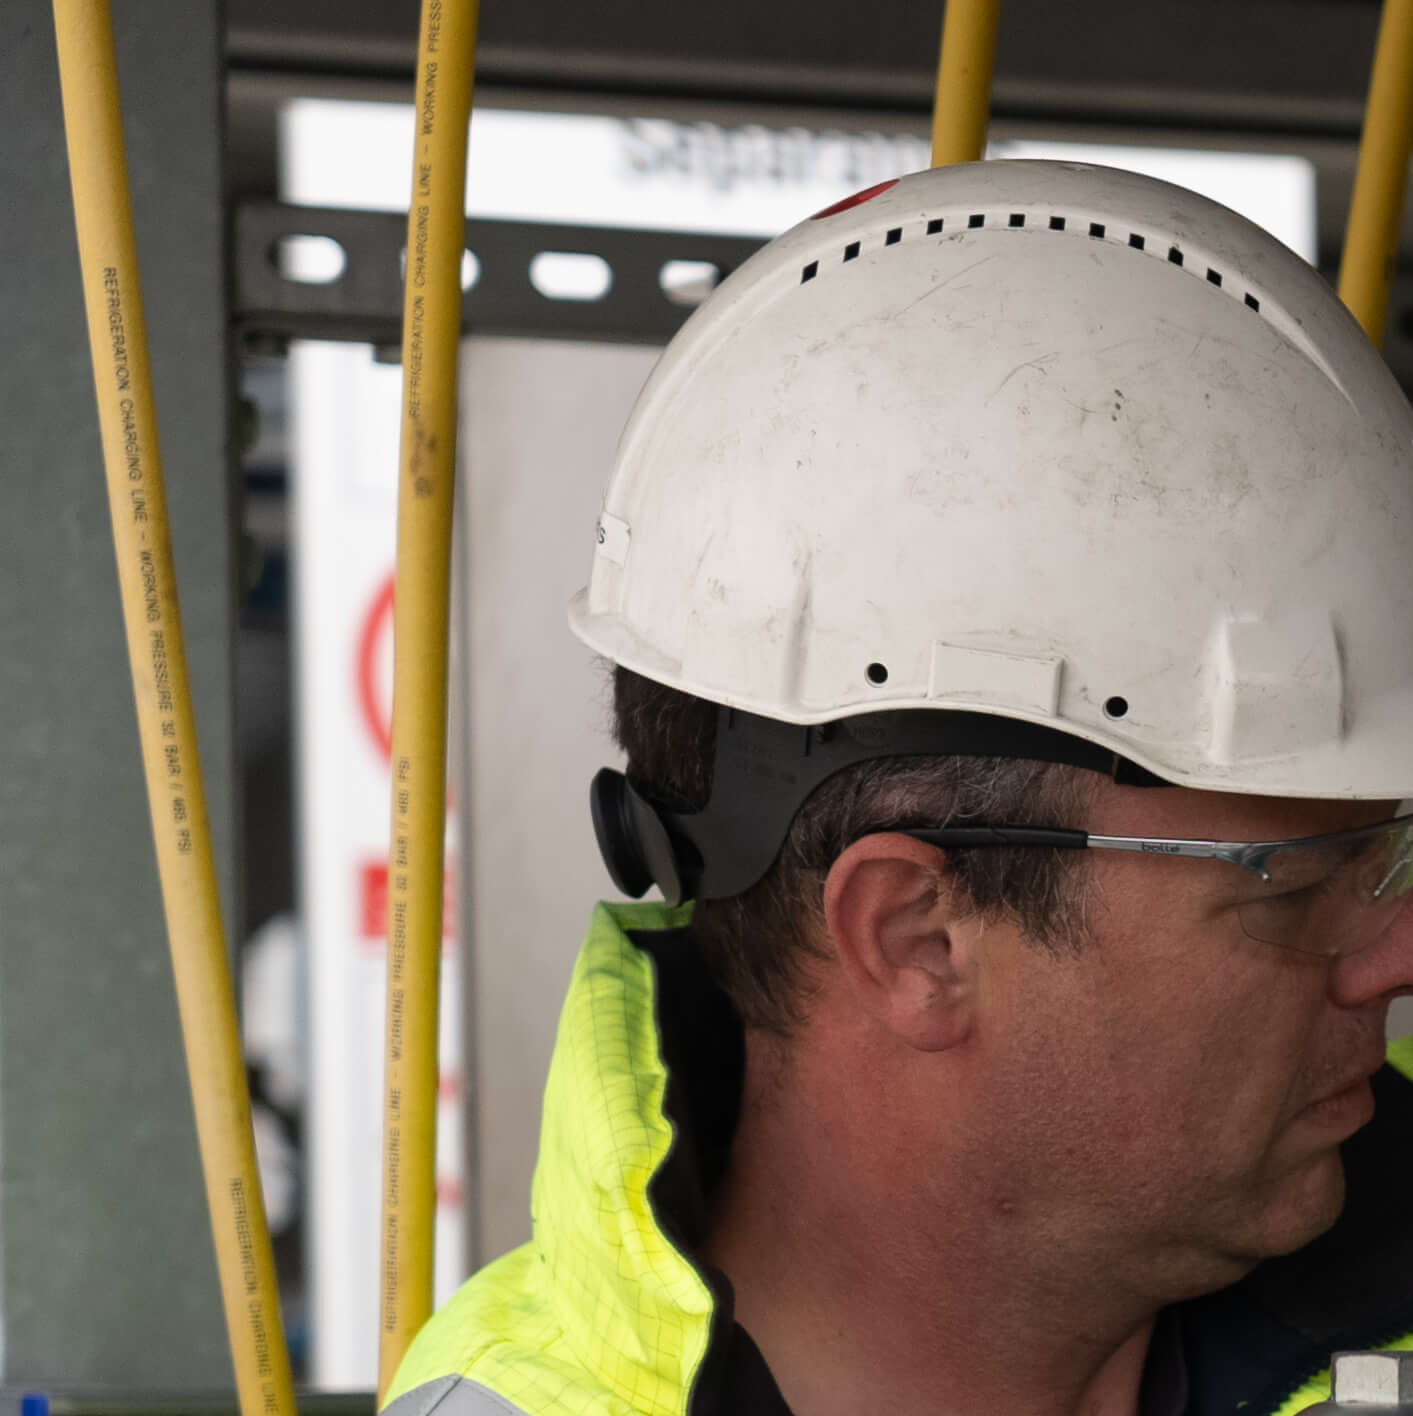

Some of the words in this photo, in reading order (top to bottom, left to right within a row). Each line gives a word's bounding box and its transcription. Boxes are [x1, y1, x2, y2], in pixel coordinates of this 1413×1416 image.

[423, 61, 439, 135] WORKING
[419, 163, 432, 197] LINE
[414, 205, 430, 287] CHARGING
[103, 266, 131, 391] REFRIGERATION
[119, 400, 143, 481] CHARGING
[130, 488, 148, 522] LINE
[140, 551, 161, 623] WORKING
[150, 630, 173, 713] PRESSURE
[164, 745, 182, 777] BAR
[177, 829, 192, 855] PSI
